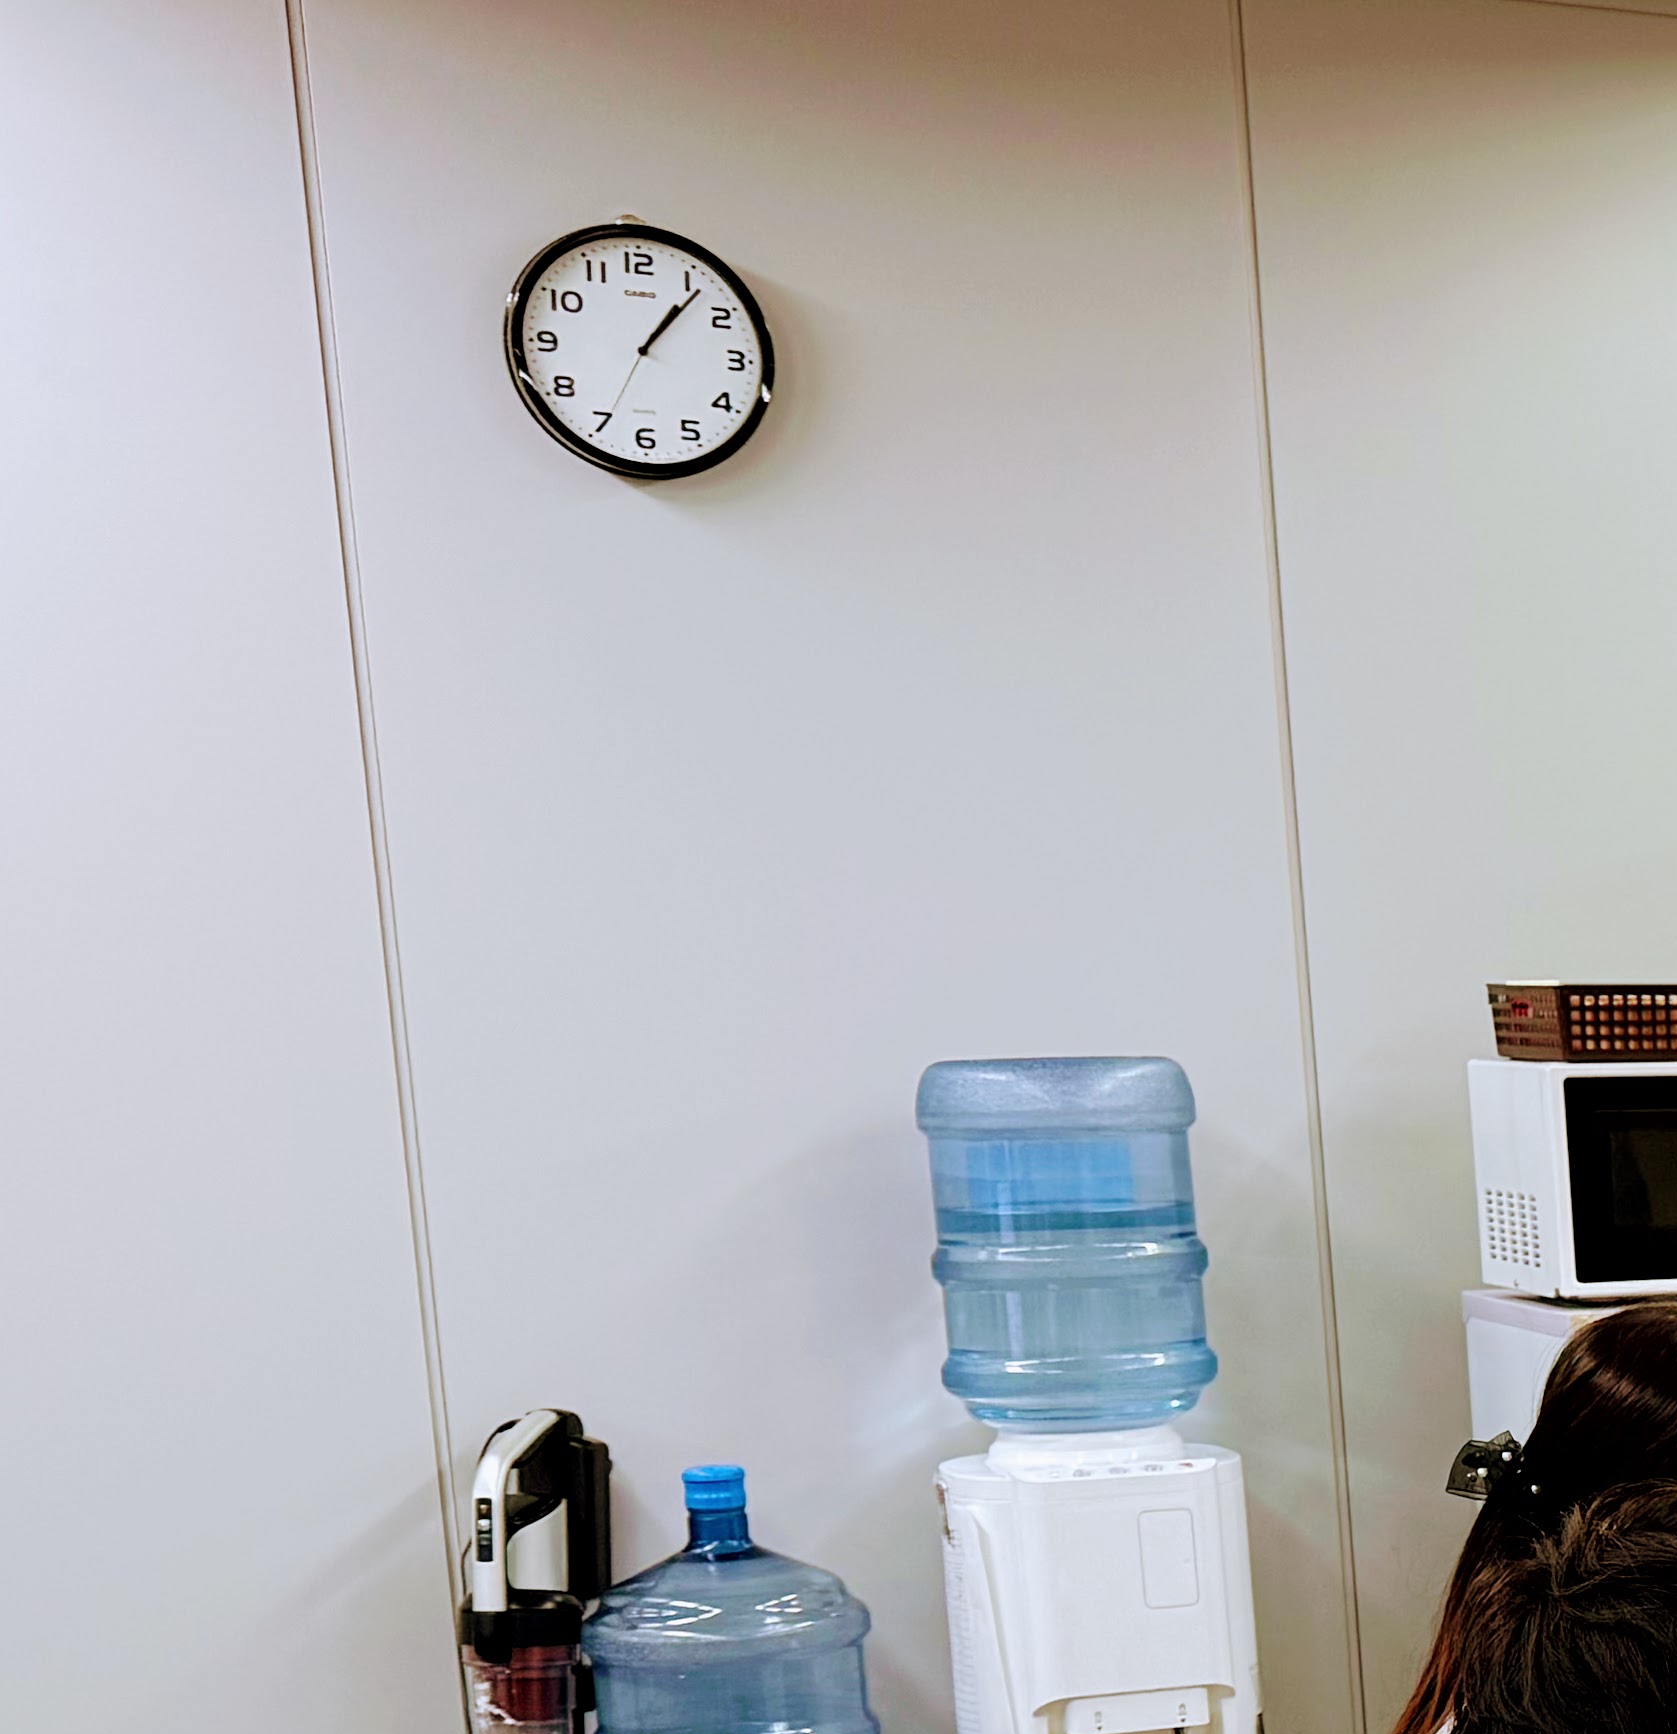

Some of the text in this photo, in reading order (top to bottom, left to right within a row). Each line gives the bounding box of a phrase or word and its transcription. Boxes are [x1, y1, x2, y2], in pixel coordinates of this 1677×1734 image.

[586, 260, 606, 283] 11
[624, 252, 654, 275] 12
[684, 271, 690, 291] 1
[551, 289, 583, 313] 10
[711, 307, 731, 329] 2
[537, 331, 558, 352] 9
[727, 350, 745, 371] 3
[553, 376, 575, 397] 8
[711, 392, 732, 413] 4
[593, 411, 613, 432] 7
[681, 419, 700, 441] 5
[635, 428, 656, 449] 6
